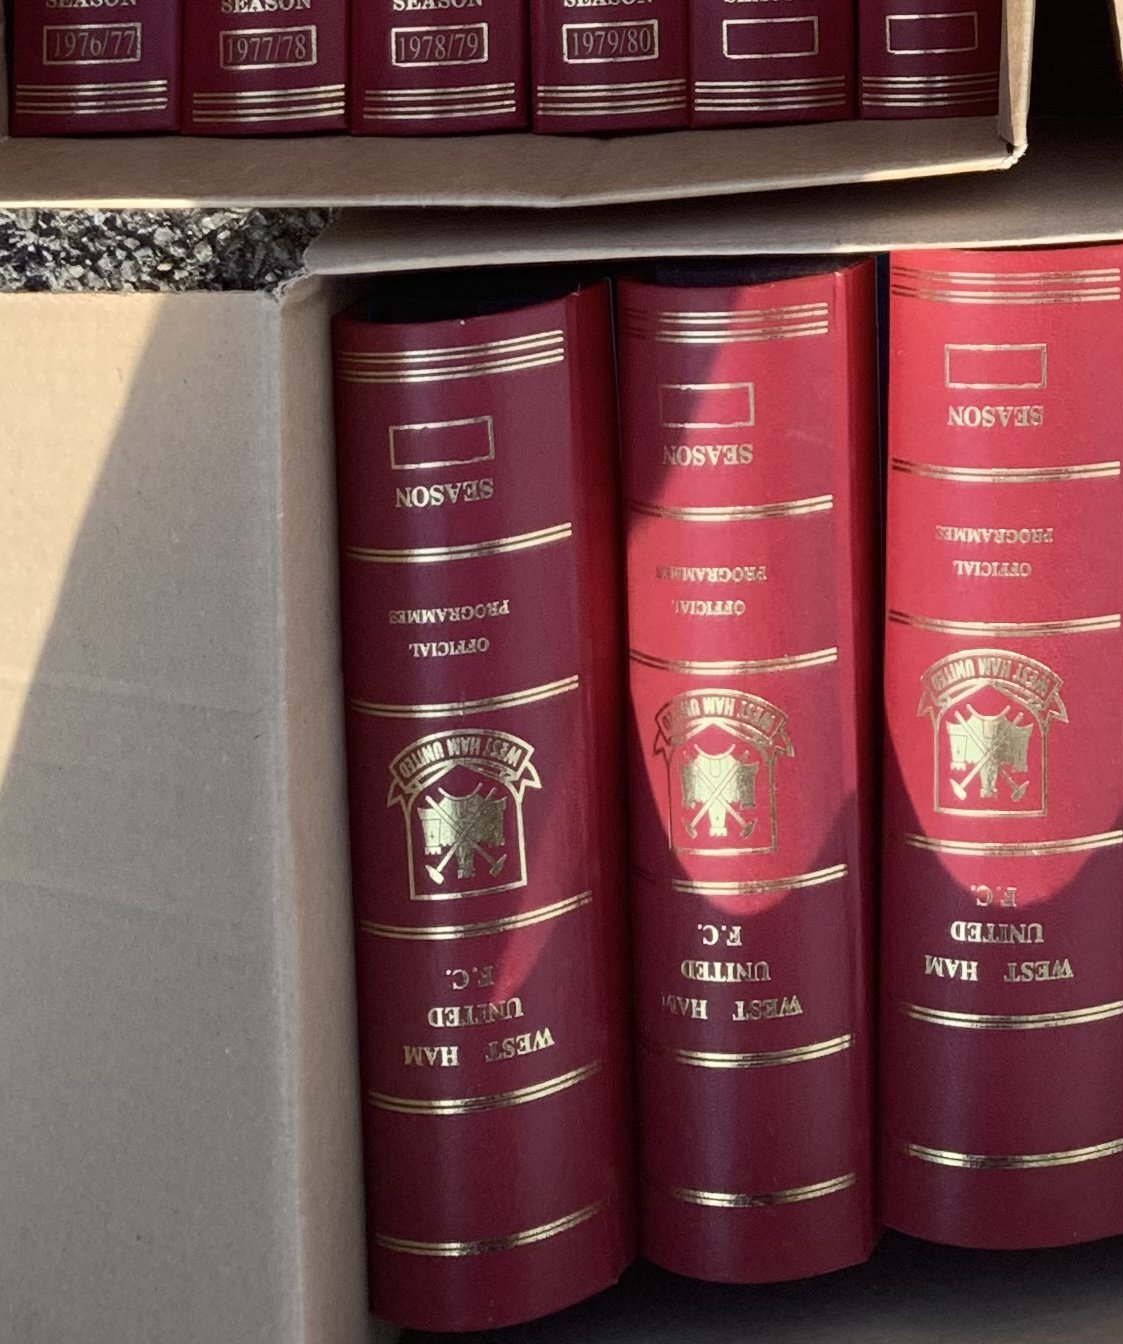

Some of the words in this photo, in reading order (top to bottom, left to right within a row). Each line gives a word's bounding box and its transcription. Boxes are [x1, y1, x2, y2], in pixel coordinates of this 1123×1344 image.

[228, 34, 306, 62] 1977/78
[400, 33, 478, 60] 1978/79
[573, 28, 650, 56] 1979/80
[947, 406, 1043, 427] SEASON
[662, 444, 753, 466] SEASON
[396, 479, 493, 507] SEASON
[950, 921, 1044, 943] UNITED
[681, 961, 771, 982] UNITED
